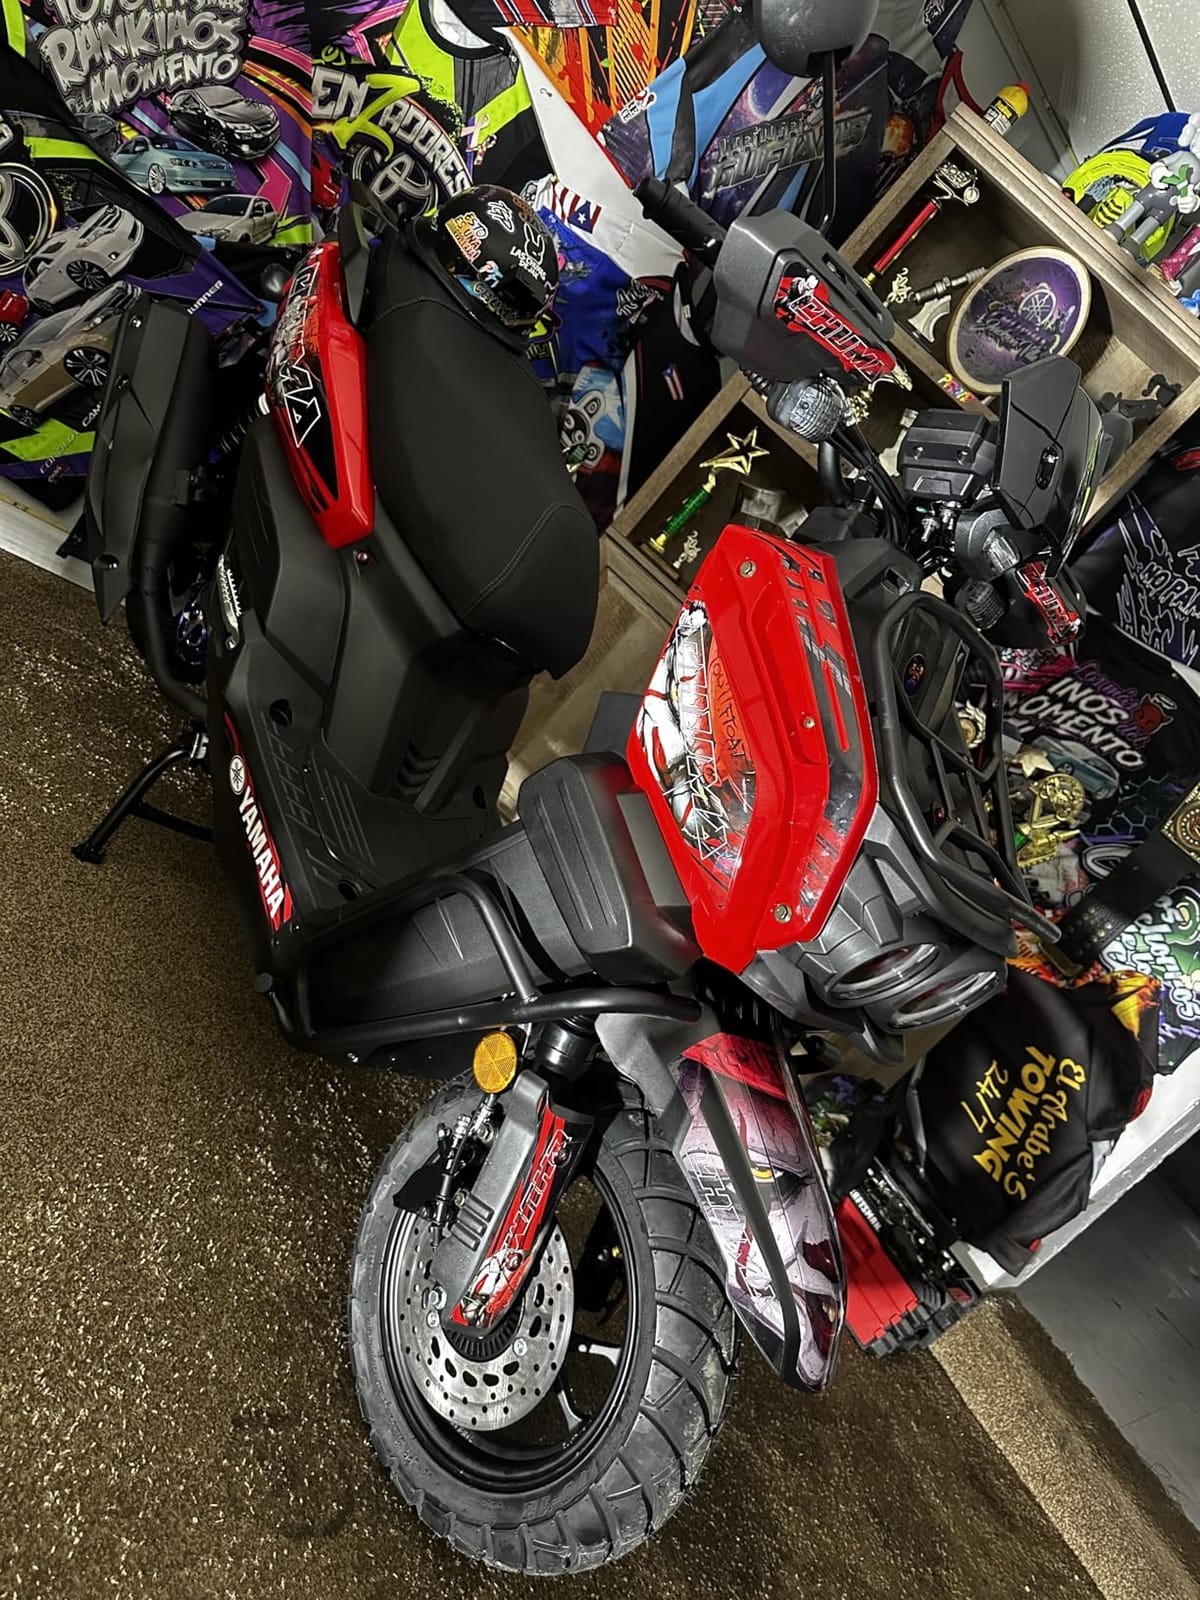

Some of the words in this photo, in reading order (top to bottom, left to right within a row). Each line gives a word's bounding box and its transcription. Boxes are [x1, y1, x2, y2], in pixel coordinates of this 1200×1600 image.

[40, 9, 242, 93] RANKIAOS
[90, 52, 239, 113] MOMENTO
[788, 293, 885, 382] CHUMA
[81, 401, 102, 428] CAM
[238, 785, 284, 918] YAMAHA
[961, 1059, 1009, 1134] 24/7
[972, 1046, 1056, 1182] TOWING
[1056, 1058, 1086, 1091] El
